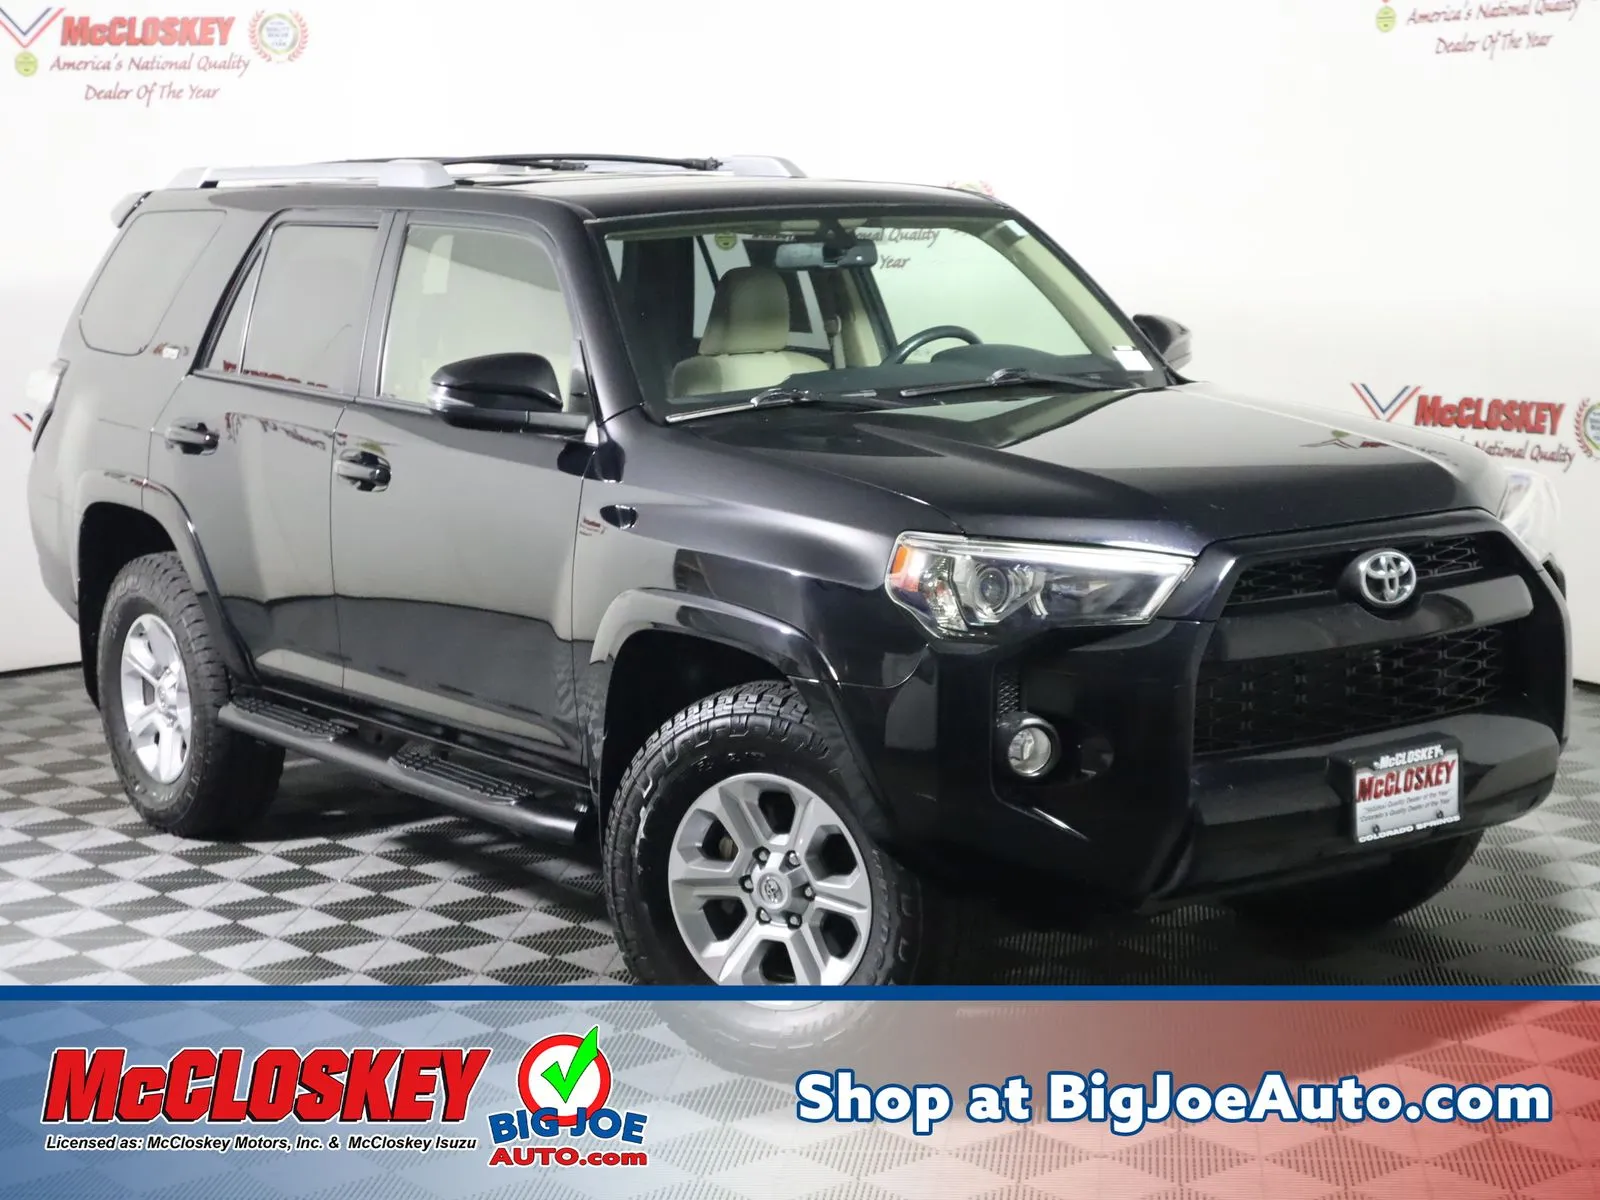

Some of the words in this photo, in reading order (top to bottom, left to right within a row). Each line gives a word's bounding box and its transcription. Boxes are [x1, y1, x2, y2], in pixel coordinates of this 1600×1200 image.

[1407, 1, 1472, 25] America's
[1476, 0, 1531, 20] National
[60, 15, 236, 47] McCLOSKEY
[1435, 33, 1480, 55] Dealer
[1502, 30, 1523, 50] The
[1526, 32, 1554, 49] Year
[50, 53, 123, 72] America's
[128, 52, 192, 72] National
[197, 51, 251, 78] Quality
[84, 81, 133, 101] Dealer
[136, 82, 158, 108] Of
[158, 82, 185, 100] The
[188, 83, 221, 100] Year
[887, 226, 941, 248] Quality
[880, 254, 911, 269] Year
[1414, 394, 1566, 436] McCLOSKEY
[1530, 443, 1576, 473] Quality
[1357, 760, 1456, 803] McCLOSKEY
[1358, 825, 1414, 843] COLORADO
